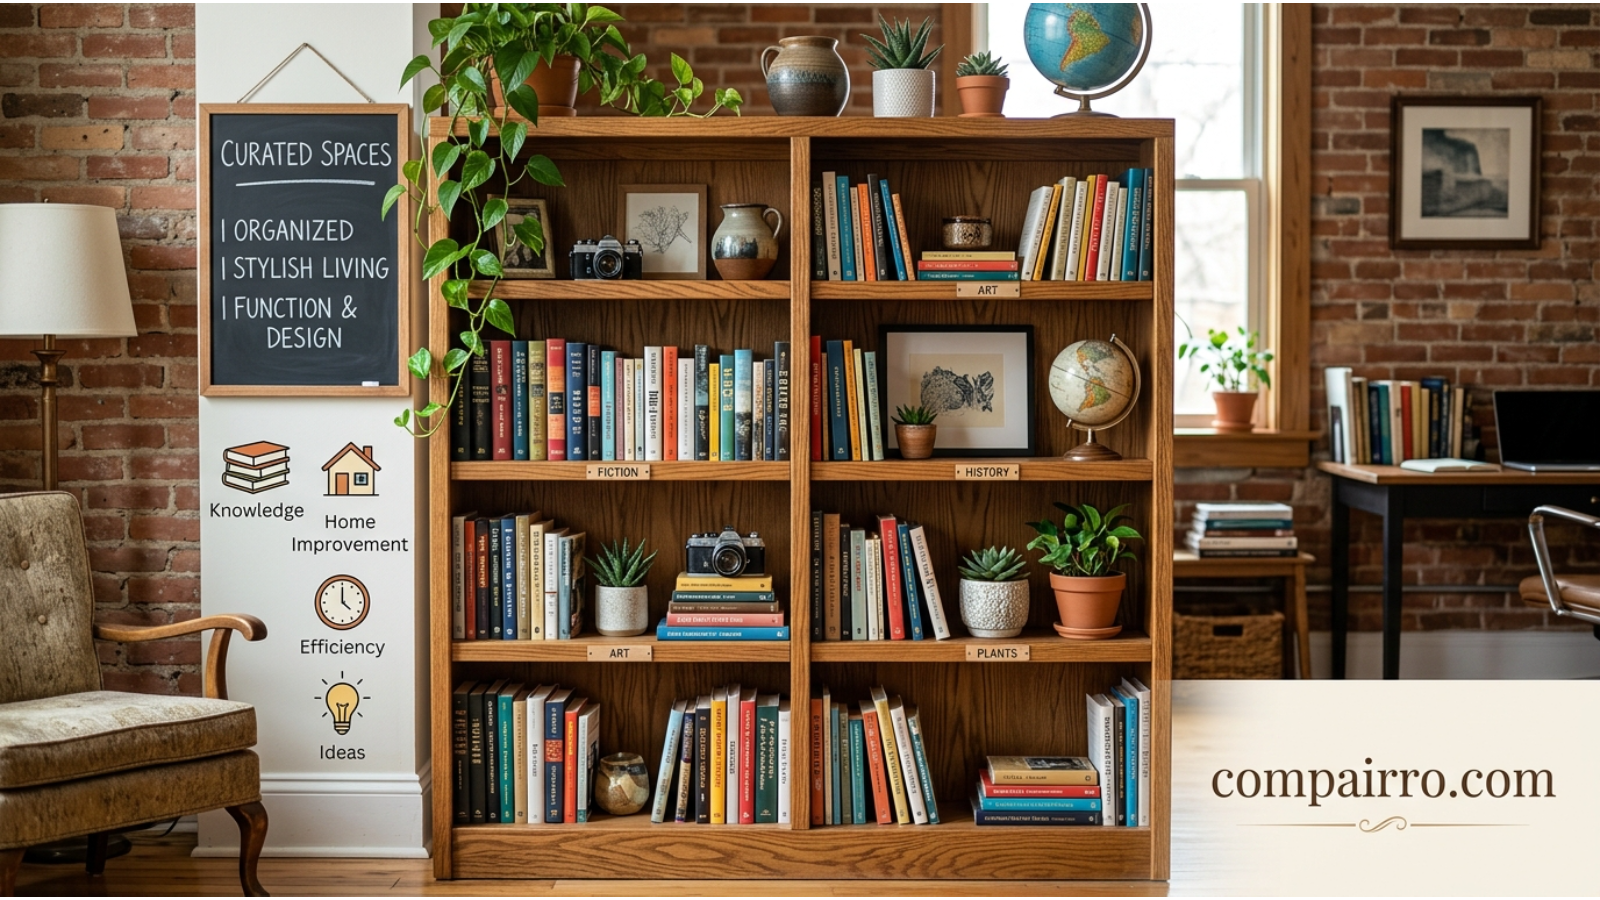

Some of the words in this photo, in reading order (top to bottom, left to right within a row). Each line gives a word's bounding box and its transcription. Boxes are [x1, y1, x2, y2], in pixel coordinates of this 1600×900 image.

[220, 139, 313, 167] CURATED
[320, 140, 392, 167] SPACES
[233, 218, 354, 242] ORGANIZED
[232, 256, 313, 279] STYLISH
[322, 256, 389, 280] LIVING
[977, 285, 998, 295] ART
[234, 296, 332, 320] FUNCTION
[341, 294, 358, 319] &
[266, 326, 342, 349] DESIGN
[597, 467, 639, 478] FICTION
[965, 467, 1010, 478] HISTORY
[209, 502, 305, 522] Knowledge
[324, 514, 376, 530] Home
[291, 536, 409, 555] Improvement
[299, 638, 386, 658] Efficiency
[609, 648, 630, 658] ART
[977, 648, 1018, 658] PLANTS
[319, 744, 366, 760] Ideas
